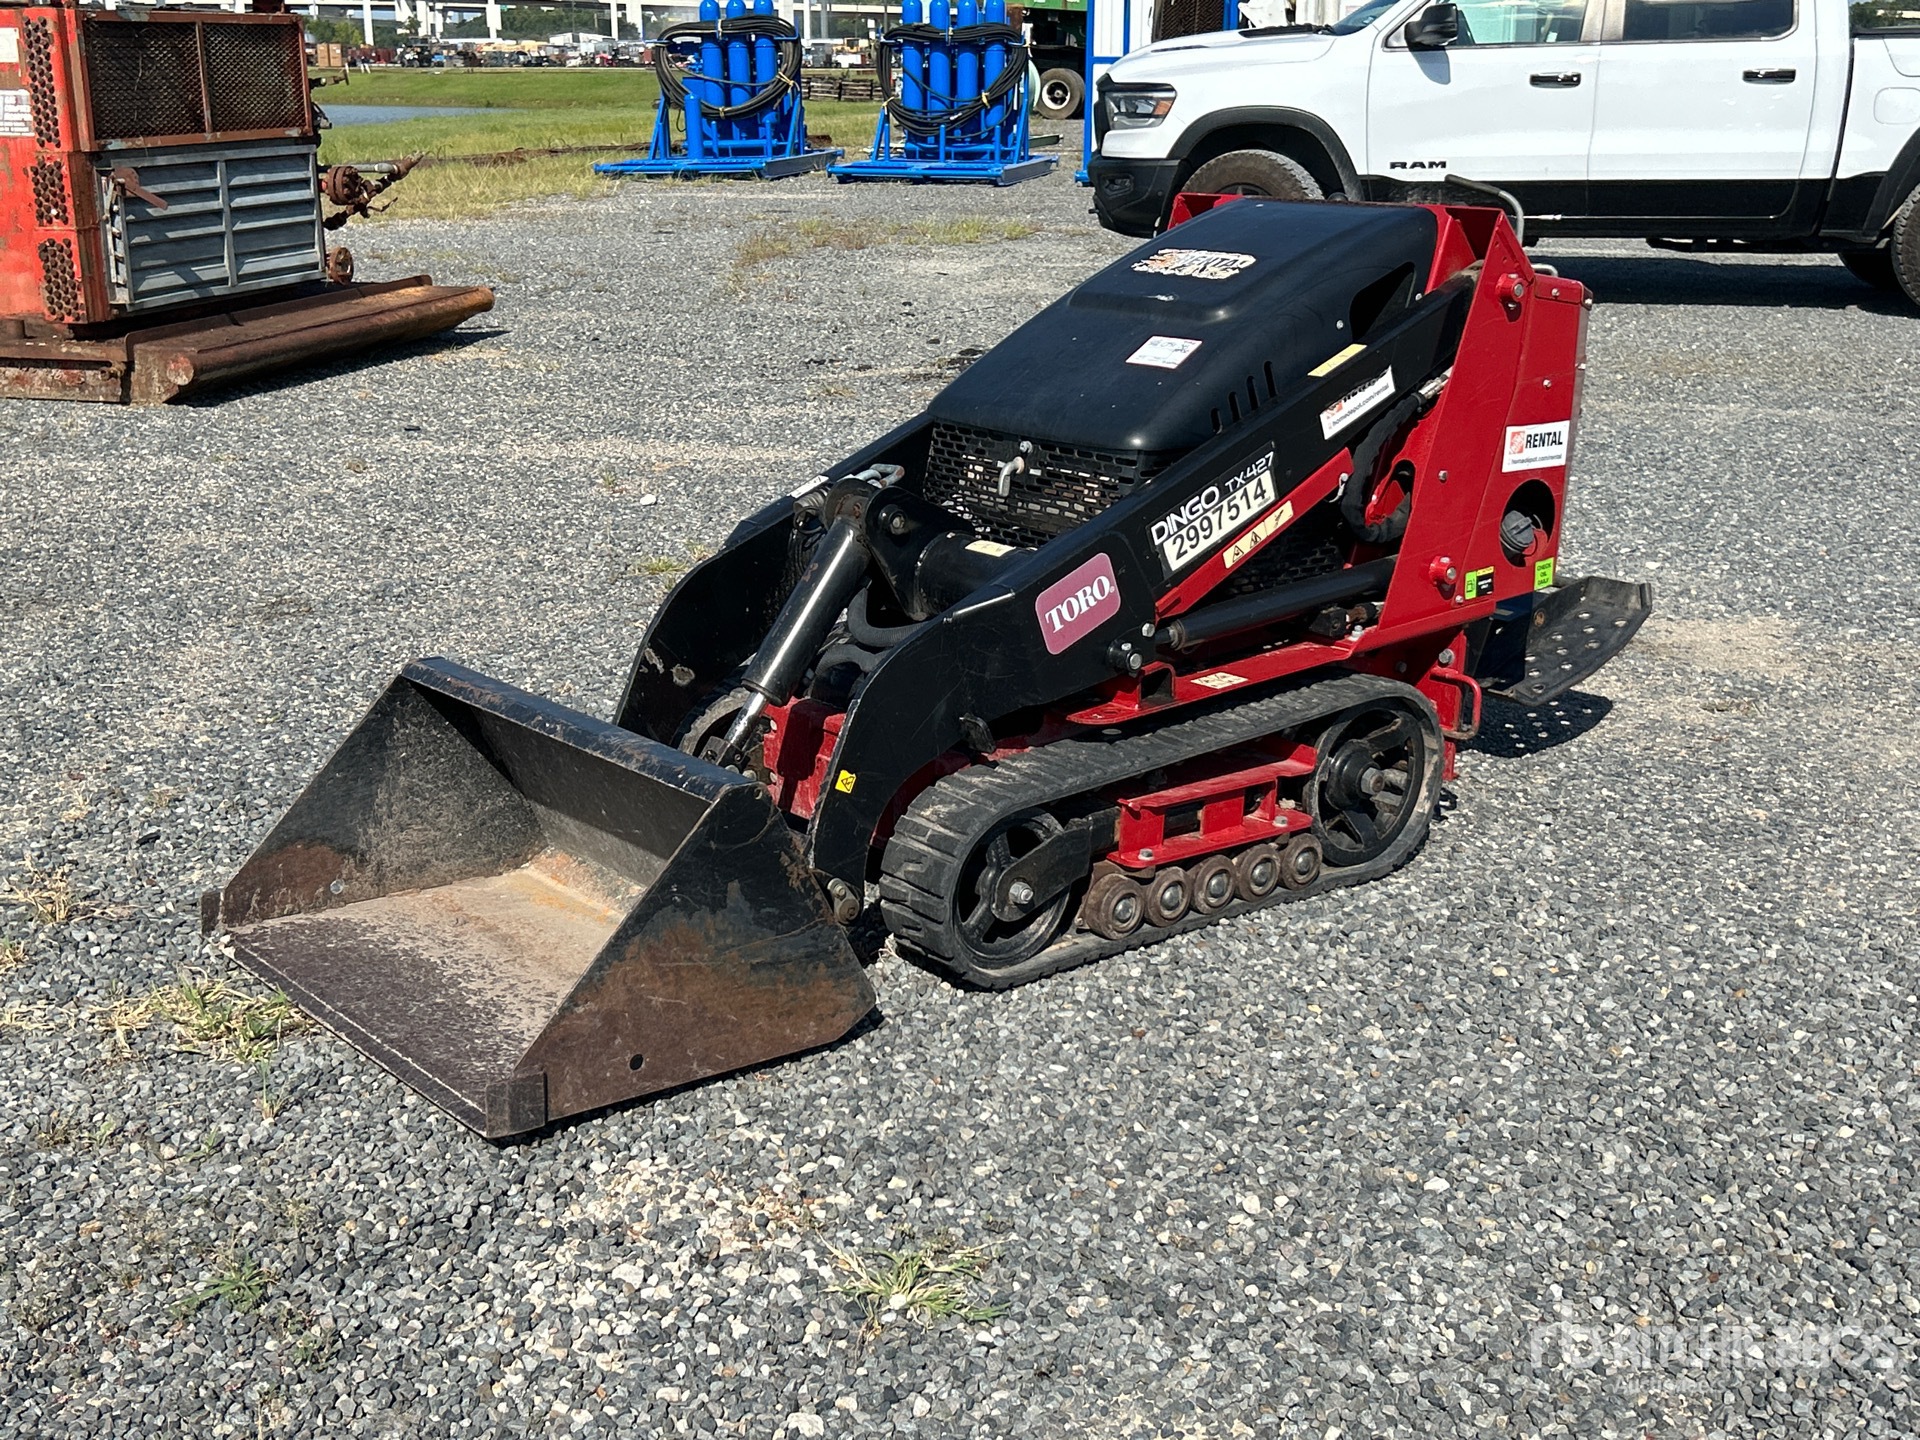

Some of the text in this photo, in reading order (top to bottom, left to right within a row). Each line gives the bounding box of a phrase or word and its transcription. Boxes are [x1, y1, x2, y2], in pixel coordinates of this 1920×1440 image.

[1389, 161, 1447, 169] RAM
[1525, 431, 1563, 449] RENTAL
[1151, 486, 1220, 546] DINGO
[1172, 477, 1267, 561] 2997514
